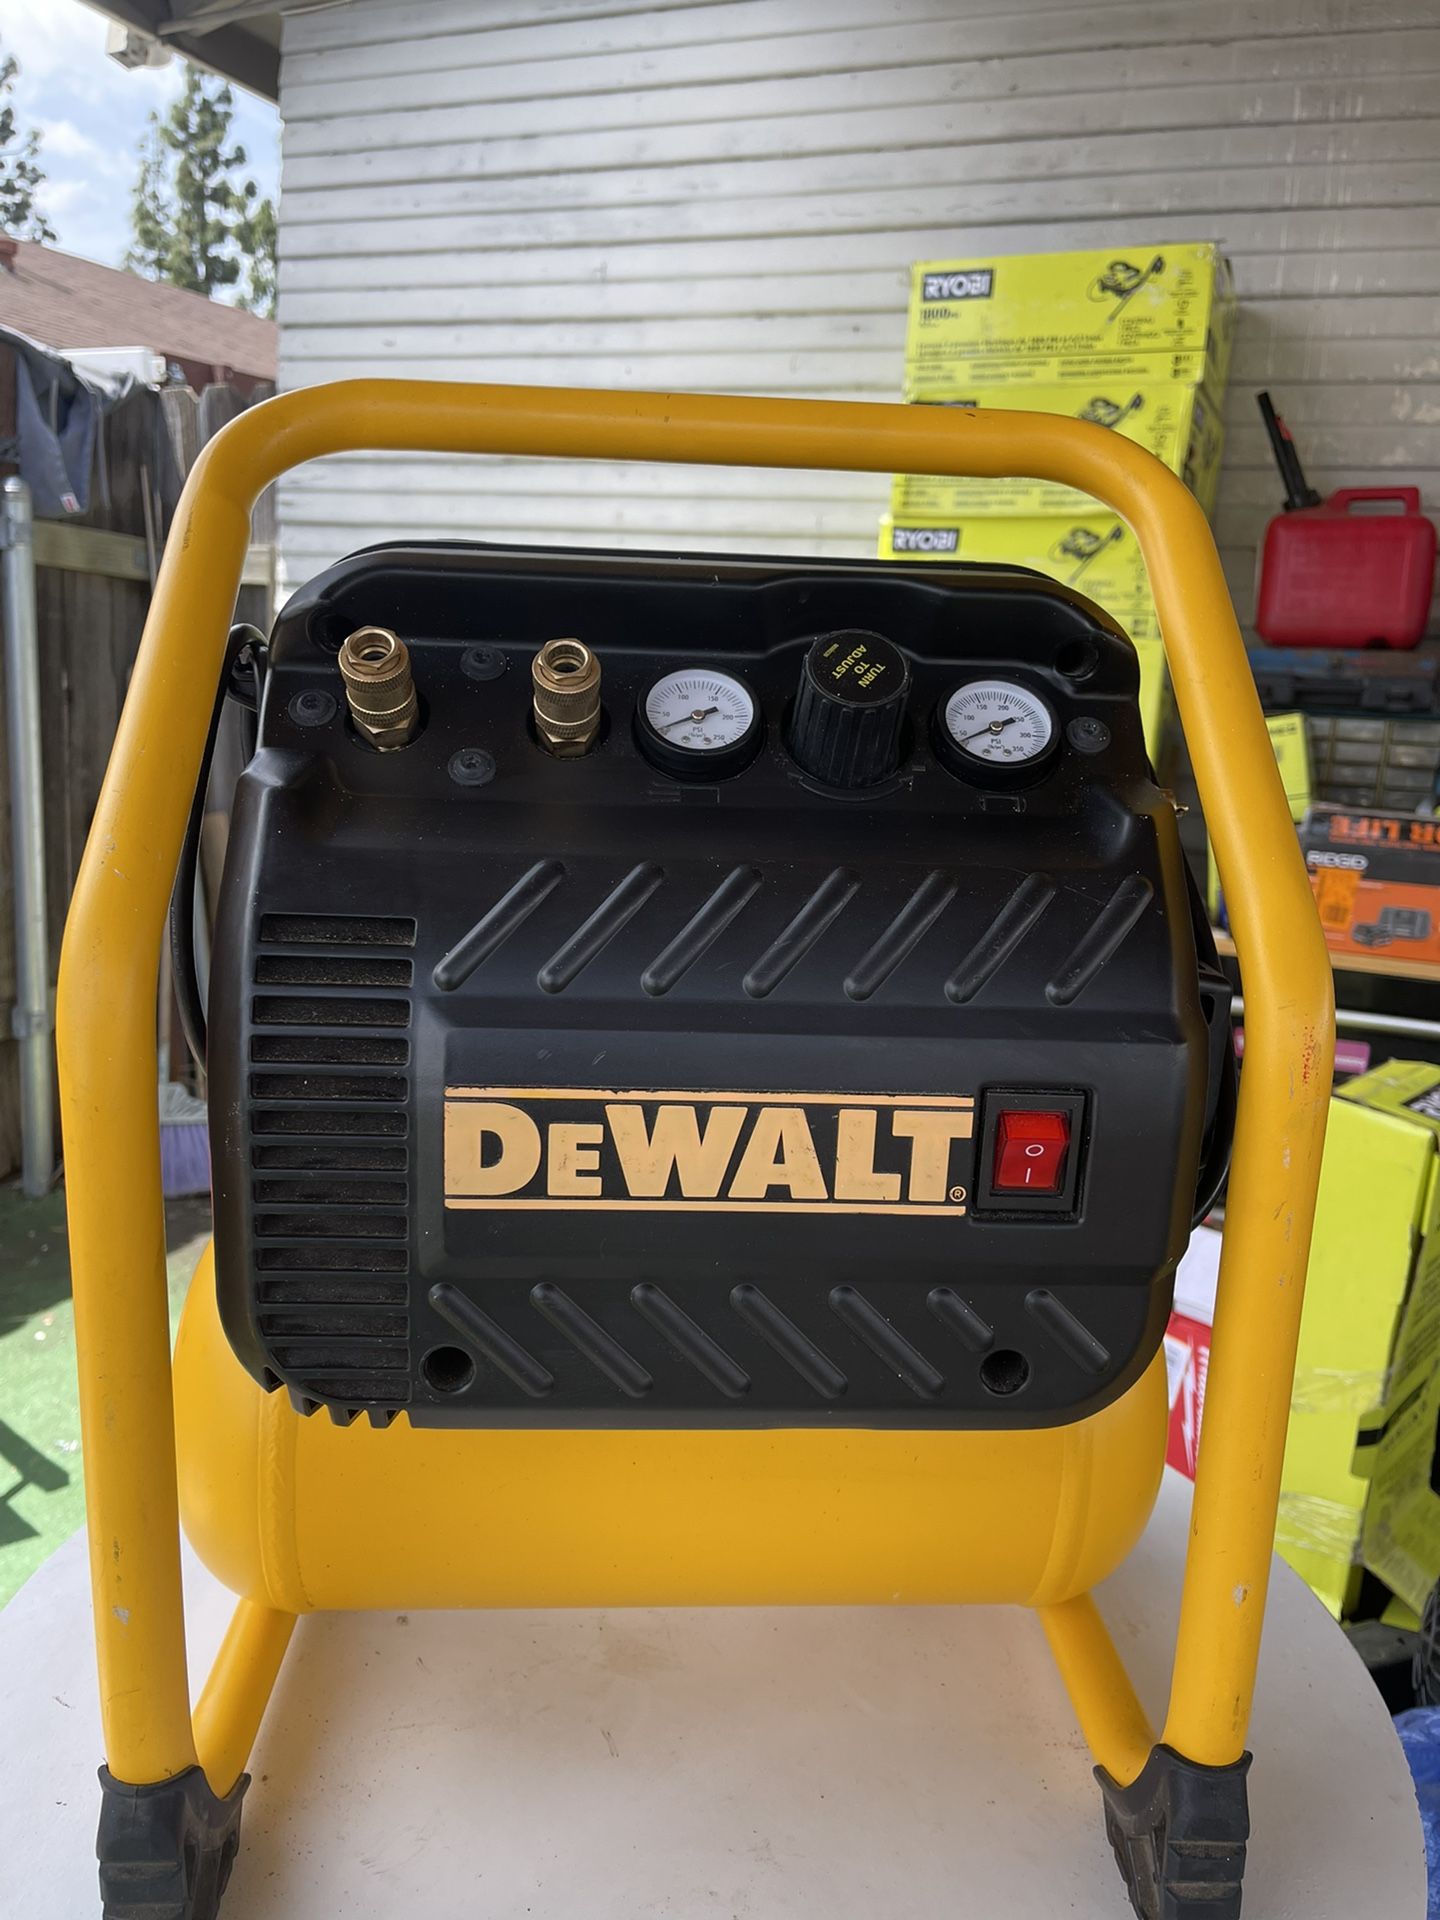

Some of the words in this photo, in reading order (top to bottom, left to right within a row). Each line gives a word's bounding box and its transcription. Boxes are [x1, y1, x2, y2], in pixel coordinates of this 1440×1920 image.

[925, 274, 991, 299] RYOBI
[893, 529, 957, 550] RYOBI
[831, 644, 867, 679] ADJUST
[853, 661, 871, 674] TO
[857, 663, 886, 688] TURN
